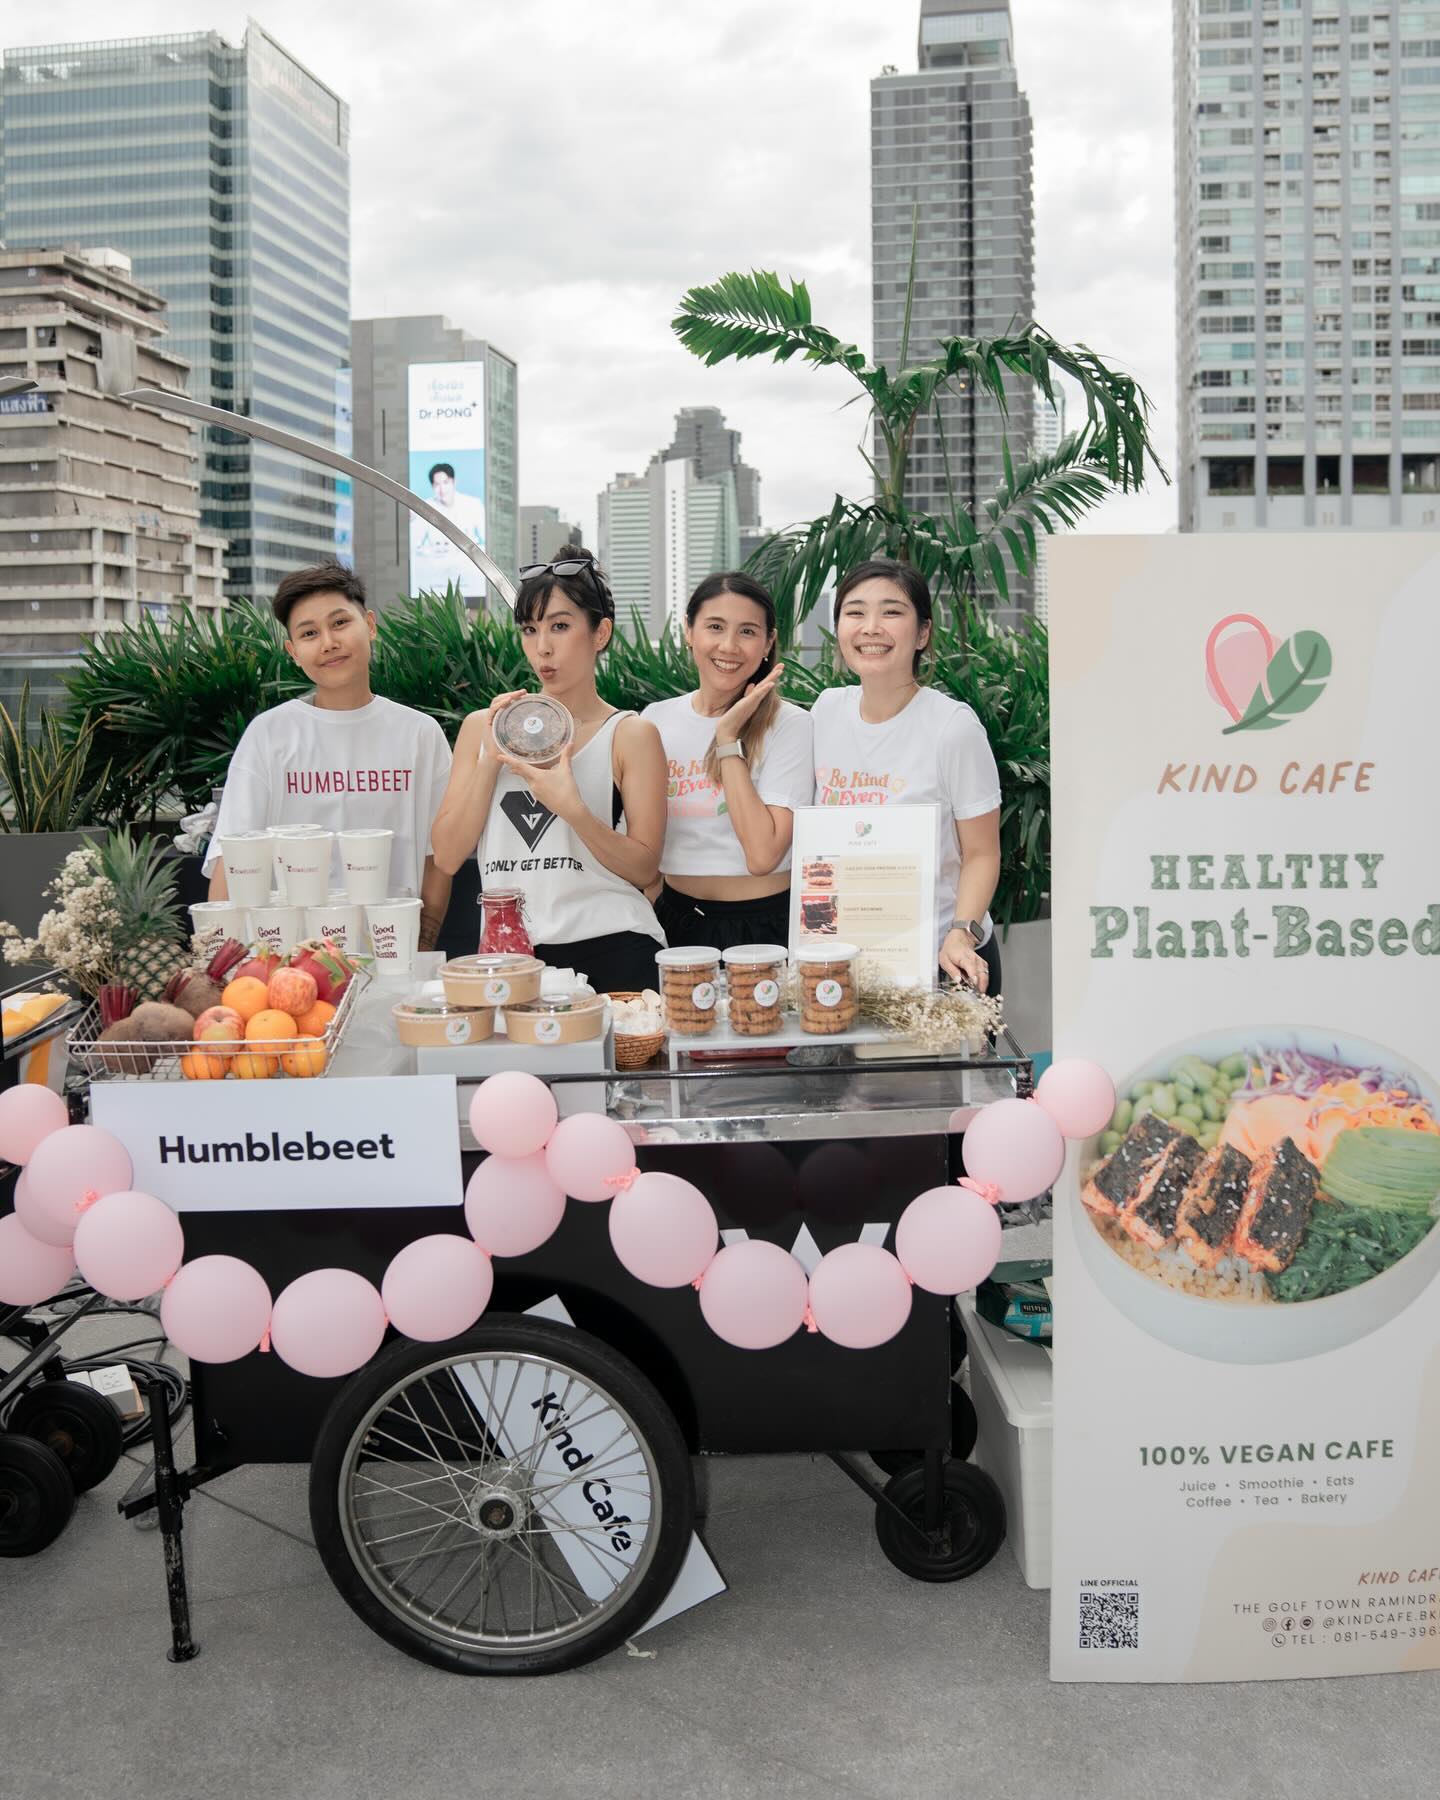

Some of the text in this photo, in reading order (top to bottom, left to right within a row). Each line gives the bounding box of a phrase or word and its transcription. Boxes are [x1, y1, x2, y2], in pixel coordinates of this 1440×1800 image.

[287, 769, 412, 794] HUMBLEBEET
[828, 768, 890, 788] Be Kind
[1157, 761, 1376, 795] KIND CAFE
[490, 860, 517, 872] ONLY
[520, 859, 540, 871] GET
[543, 857, 584, 872] BETTER
[1150, 853, 1384, 890] HEALTHY
[257, 926, 280, 938] Good
[321, 925, 346, 937] Good
[373, 924, 394, 935] Good
[1089, 904, 1440, 959] Plant-Based
[159, 1131, 395, 1164] Humblebeet
[1139, 1439, 1394, 1466] 100% VEGAN CAFE
[530, 1391, 632, 1552] Kind Cafe
[1178, 1475, 1355, 1492] Juice Smoothie Eats
[1186, 1493, 1347, 1508] Coffee Tea Bakery
[1080, 1579, 1138, 1587] LINE OFFICIAL
[1358, 1567, 1440, 1586] KIND CAF
[1233, 1593, 1440, 1614] THE GOLF TOWN RAMINDR
[1322, 1610, 1440, 1629] @KINDCAFE.BK
[1291, 1634, 1315, 1645] TEL
[1334, 1626, 1440, 1643] 081-549-396
